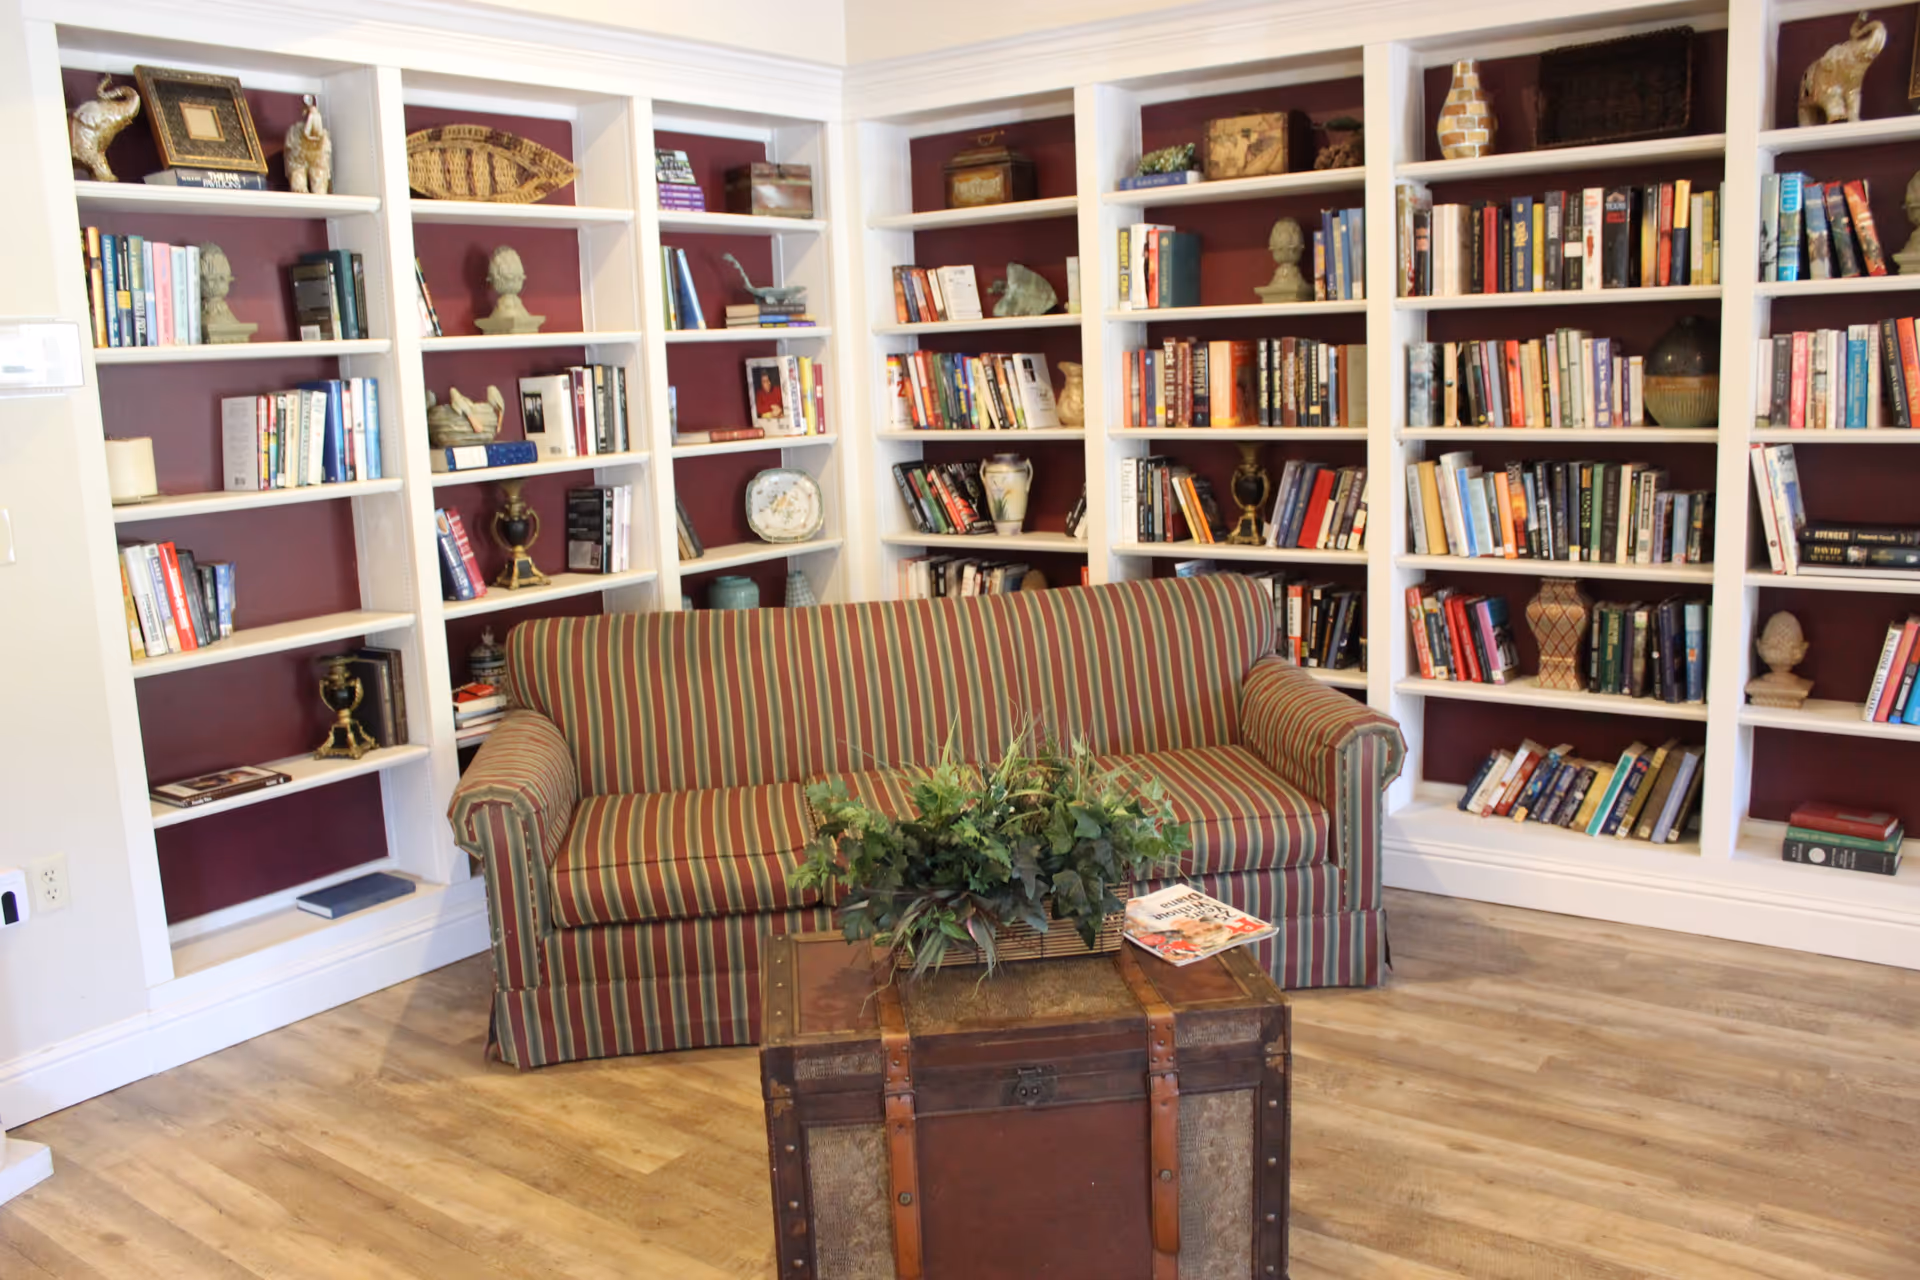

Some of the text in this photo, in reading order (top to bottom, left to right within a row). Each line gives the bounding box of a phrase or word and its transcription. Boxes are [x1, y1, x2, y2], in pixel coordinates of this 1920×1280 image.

[1122, 463, 1133, 502] Dutch
[1815, 530, 1849, 541] AVENGER
[1814, 545, 1840, 556] DAVID
[1160, 892, 1204, 909] Diana
[1152, 901, 1210, 920] Without
[1184, 904, 1227, 919] Years
[1214, 910, 1236, 921] 25
